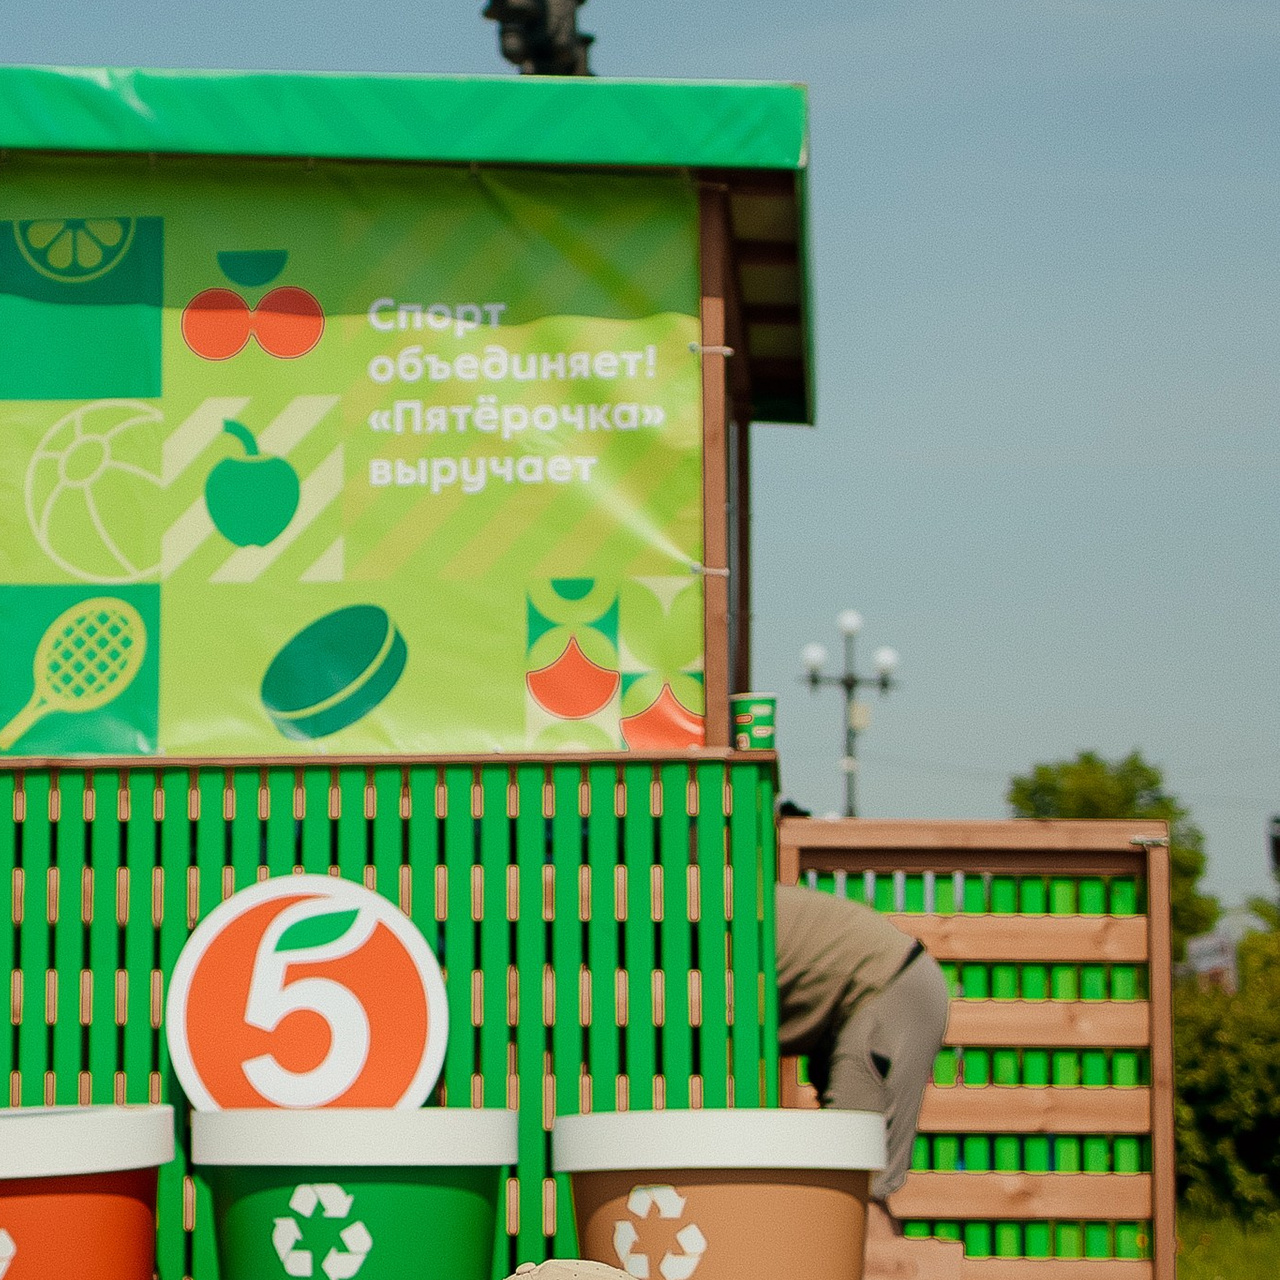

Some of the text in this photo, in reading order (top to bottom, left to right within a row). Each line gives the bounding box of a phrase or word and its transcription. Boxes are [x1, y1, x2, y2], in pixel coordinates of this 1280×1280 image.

[367, 296, 507, 338] Спорт
[367, 344, 658, 384] объединяет!
[368, 395, 665, 441] «Пятёрочка»
[369, 455, 598, 494] выручает
[241, 898, 382, 1109] 5
